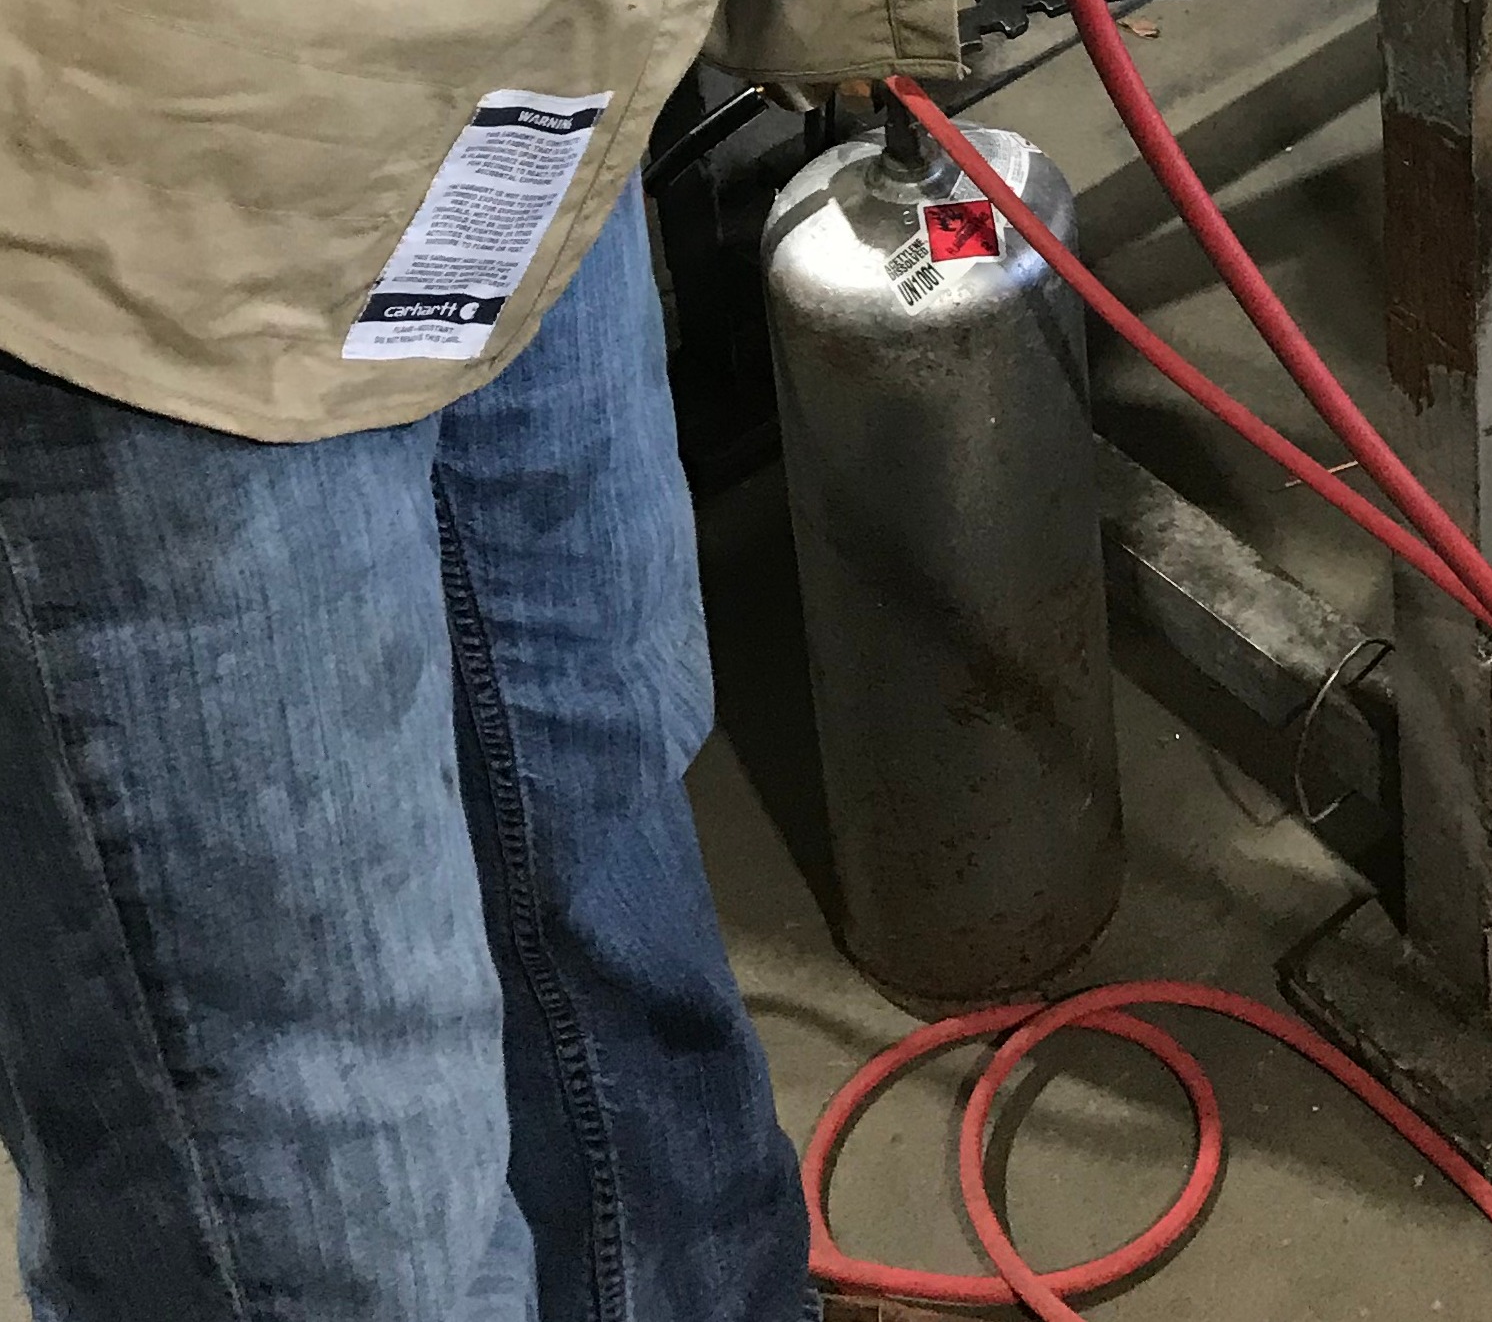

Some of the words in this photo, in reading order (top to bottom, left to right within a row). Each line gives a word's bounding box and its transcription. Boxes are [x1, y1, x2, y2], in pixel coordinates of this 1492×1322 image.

[884, 237, 926, 274] ACETYLENE
[890, 247, 930, 281] DISSOLVED
[897, 263, 945, 307] UN1001
[384, 302, 457, 318] carhartt
